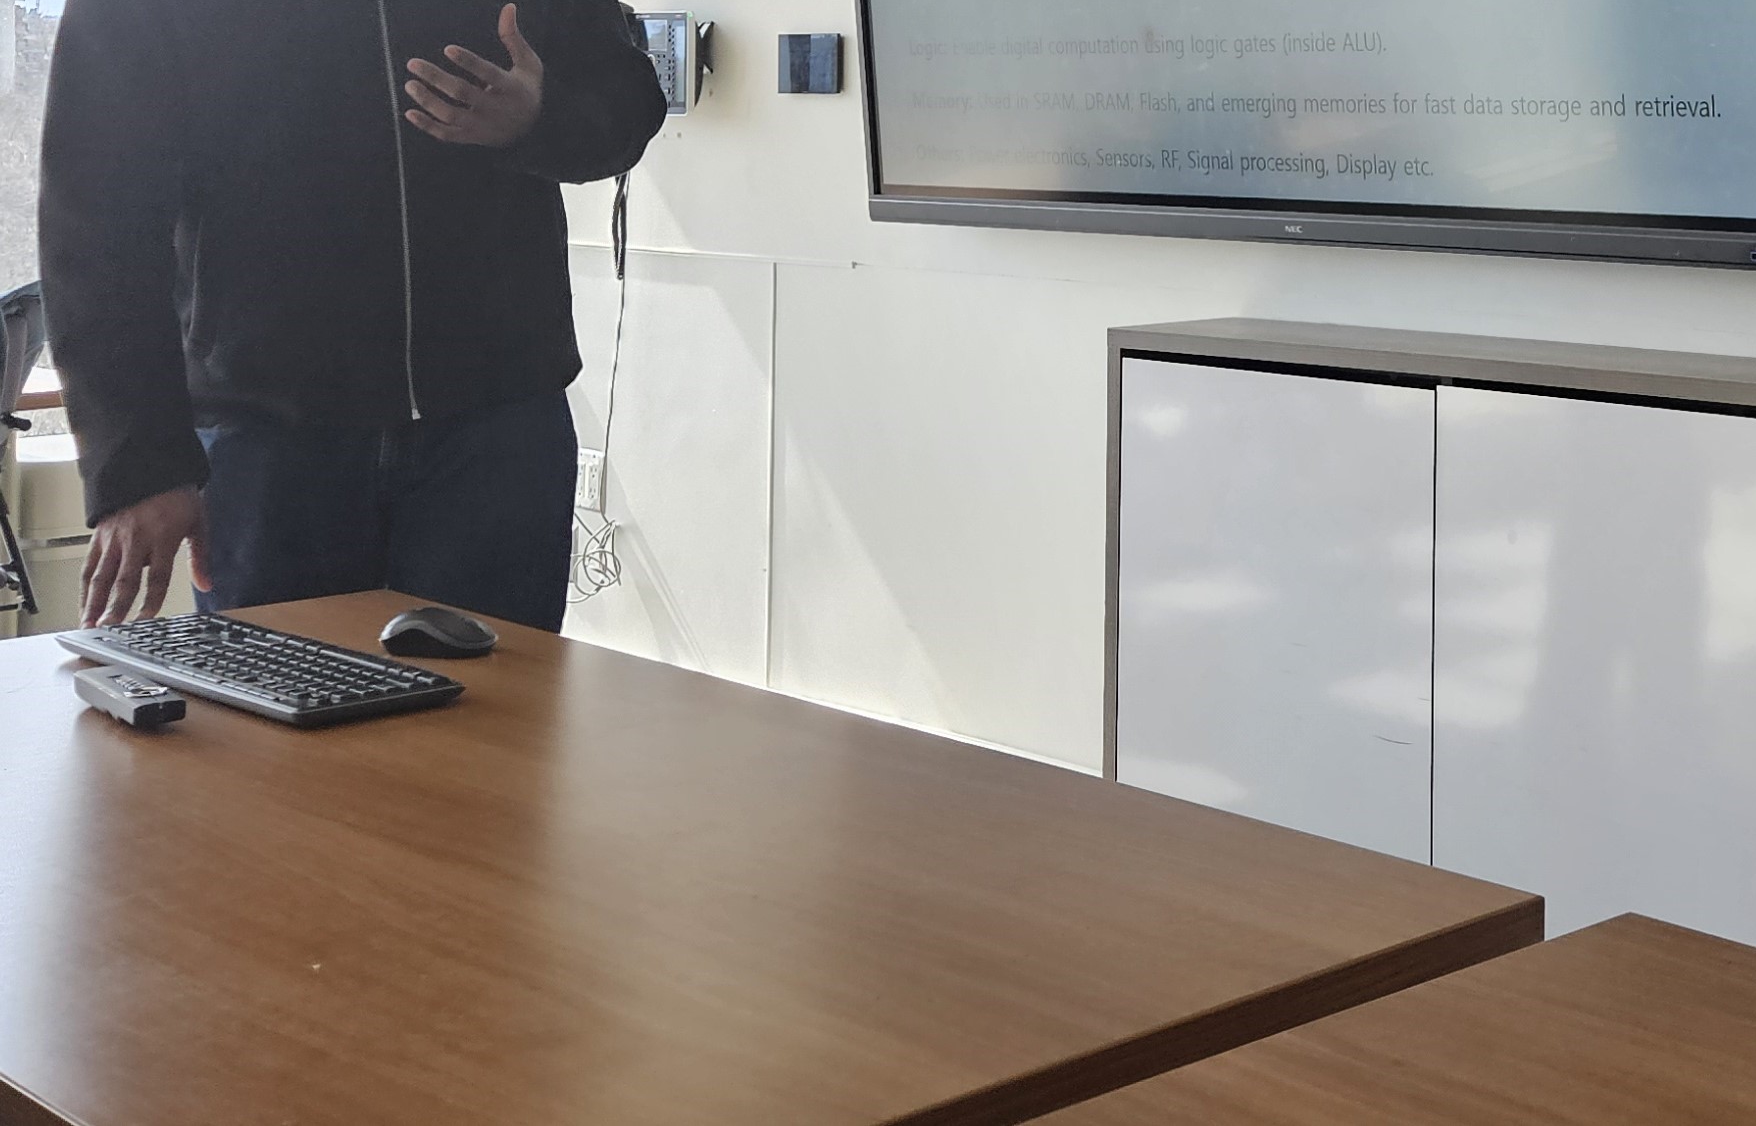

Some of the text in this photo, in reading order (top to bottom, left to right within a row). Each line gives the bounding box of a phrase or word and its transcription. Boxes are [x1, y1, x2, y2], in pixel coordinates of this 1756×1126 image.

[1048, 36, 1138, 60] computation
[1145, 35, 1184, 61] using
[1190, 32, 1229, 58] logic
[1233, 35, 1276, 58] gates
[1281, 32, 1336, 57] (inside
[1342, 32, 1388, 57] ALU).
[1085, 92, 1133, 114] DRAM,
[1140, 92, 1181, 114] Flash,
[1187, 92, 1215, 114] and
[1221, 94, 1297, 119] emerging
[1303, 93, 1386, 116] memories
[1392, 93, 1418, 116] for
[1424, 93, 1456, 117] fast
[1463, 94, 1503, 117] data
[1510, 95, 1582, 123] storage
[1589, 94, 1626, 118] and
[1634, 94, 1722, 120] retrieval.
[1096, 148, 1156, 172] Sensors,
[1160, 149, 1182, 173] RF,
[1187, 149, 1234, 176] Signal
[1240, 152, 1330, 178] processing,
[1336, 154, 1396, 181] Display
[1403, 156, 1435, 178] etc.
[1285, 224, 1303, 235] NEC
